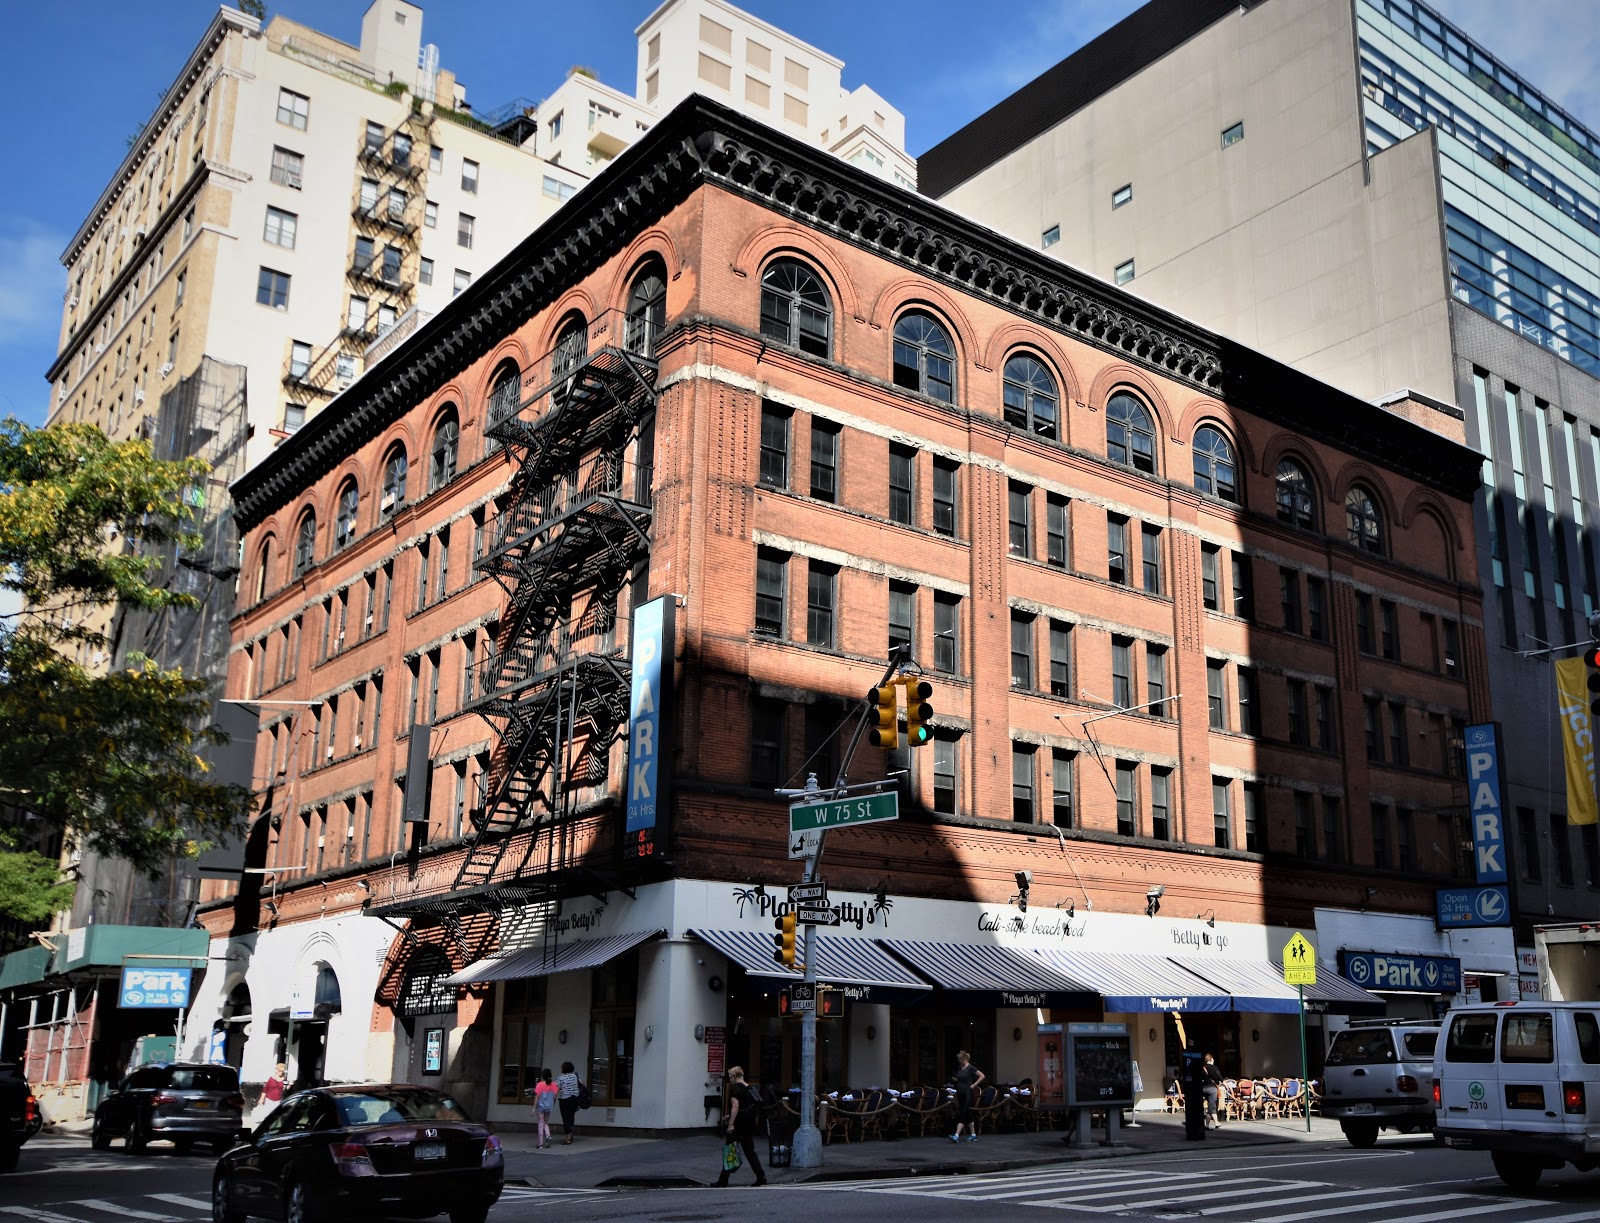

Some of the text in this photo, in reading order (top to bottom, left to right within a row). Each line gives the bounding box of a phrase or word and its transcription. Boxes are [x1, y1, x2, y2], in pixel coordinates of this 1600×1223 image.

[632, 636, 656, 801] PARK
[628, 807, 638, 819] 24
[815, 801, 872, 824] W 75 St
[1470, 752, 1502, 873] PARK
[792, 888, 820, 898] ONE WAY
[1444, 894, 1468, 904] Open
[1441, 903, 1451, 913] 24
[571, 911, 594, 931] Betty's
[803, 911, 835, 921] ONE WAY
[1030, 916, 1061, 938] beach
[1061, 919, 1086, 941] food
[1170, 927, 1200, 950] Betty
[1216, 936, 1228, 951] go
[1288, 971, 1312, 981] AHEAD
[1373, 957, 1423, 987] Park
[125, 971, 187, 990] Park
[792, 1001, 814, 1010] BIKE LANE
[1187, 1058, 1192, 1066] P
[1470, 1101, 1488, 1110] 7310
